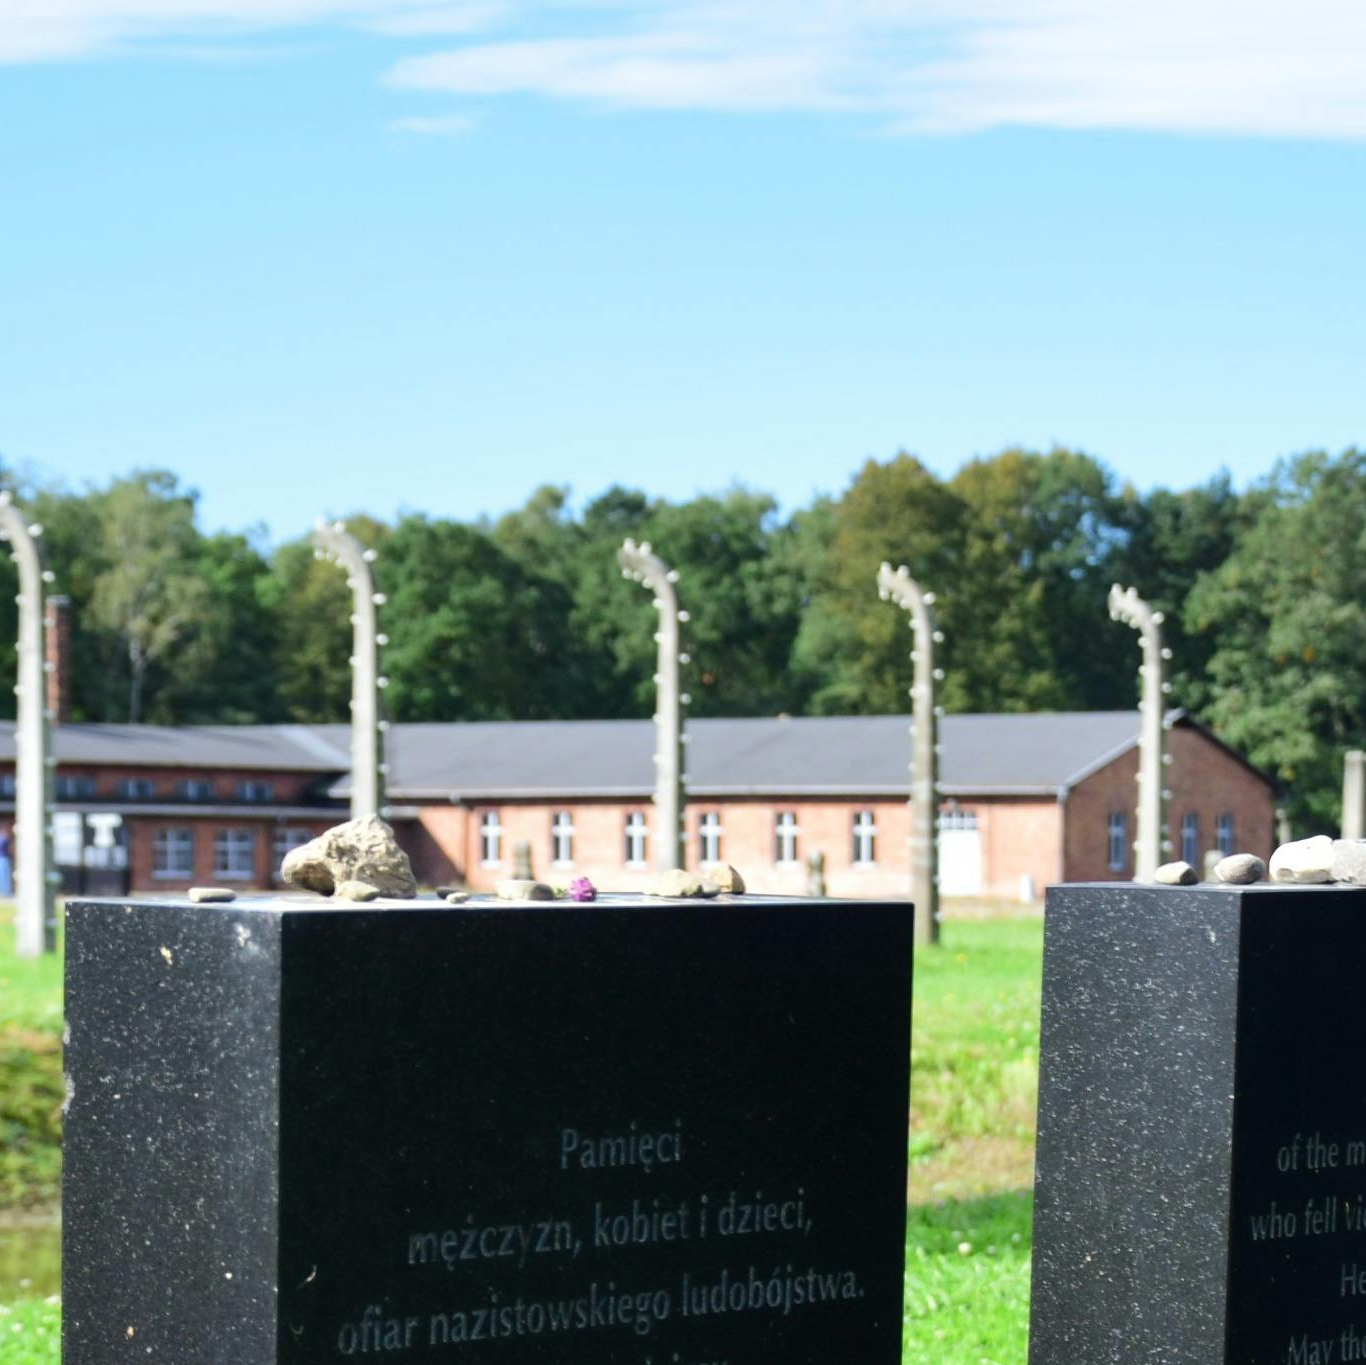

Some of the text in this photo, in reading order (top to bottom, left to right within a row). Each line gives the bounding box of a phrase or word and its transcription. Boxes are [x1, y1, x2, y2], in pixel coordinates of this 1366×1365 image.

[560, 1118, 682, 1173] Pamięci
[1277, 1132, 1303, 1172] of
[1306, 1131, 1339, 1169] the
[407, 1187, 813, 1270] mężczyzn, kobiet i dzieci,
[1250, 1201, 1296, 1240] who
[1304, 1195, 1337, 1235] fell
[338, 1265, 866, 1355] ofiar nazistowskiego ludobójstwa.
